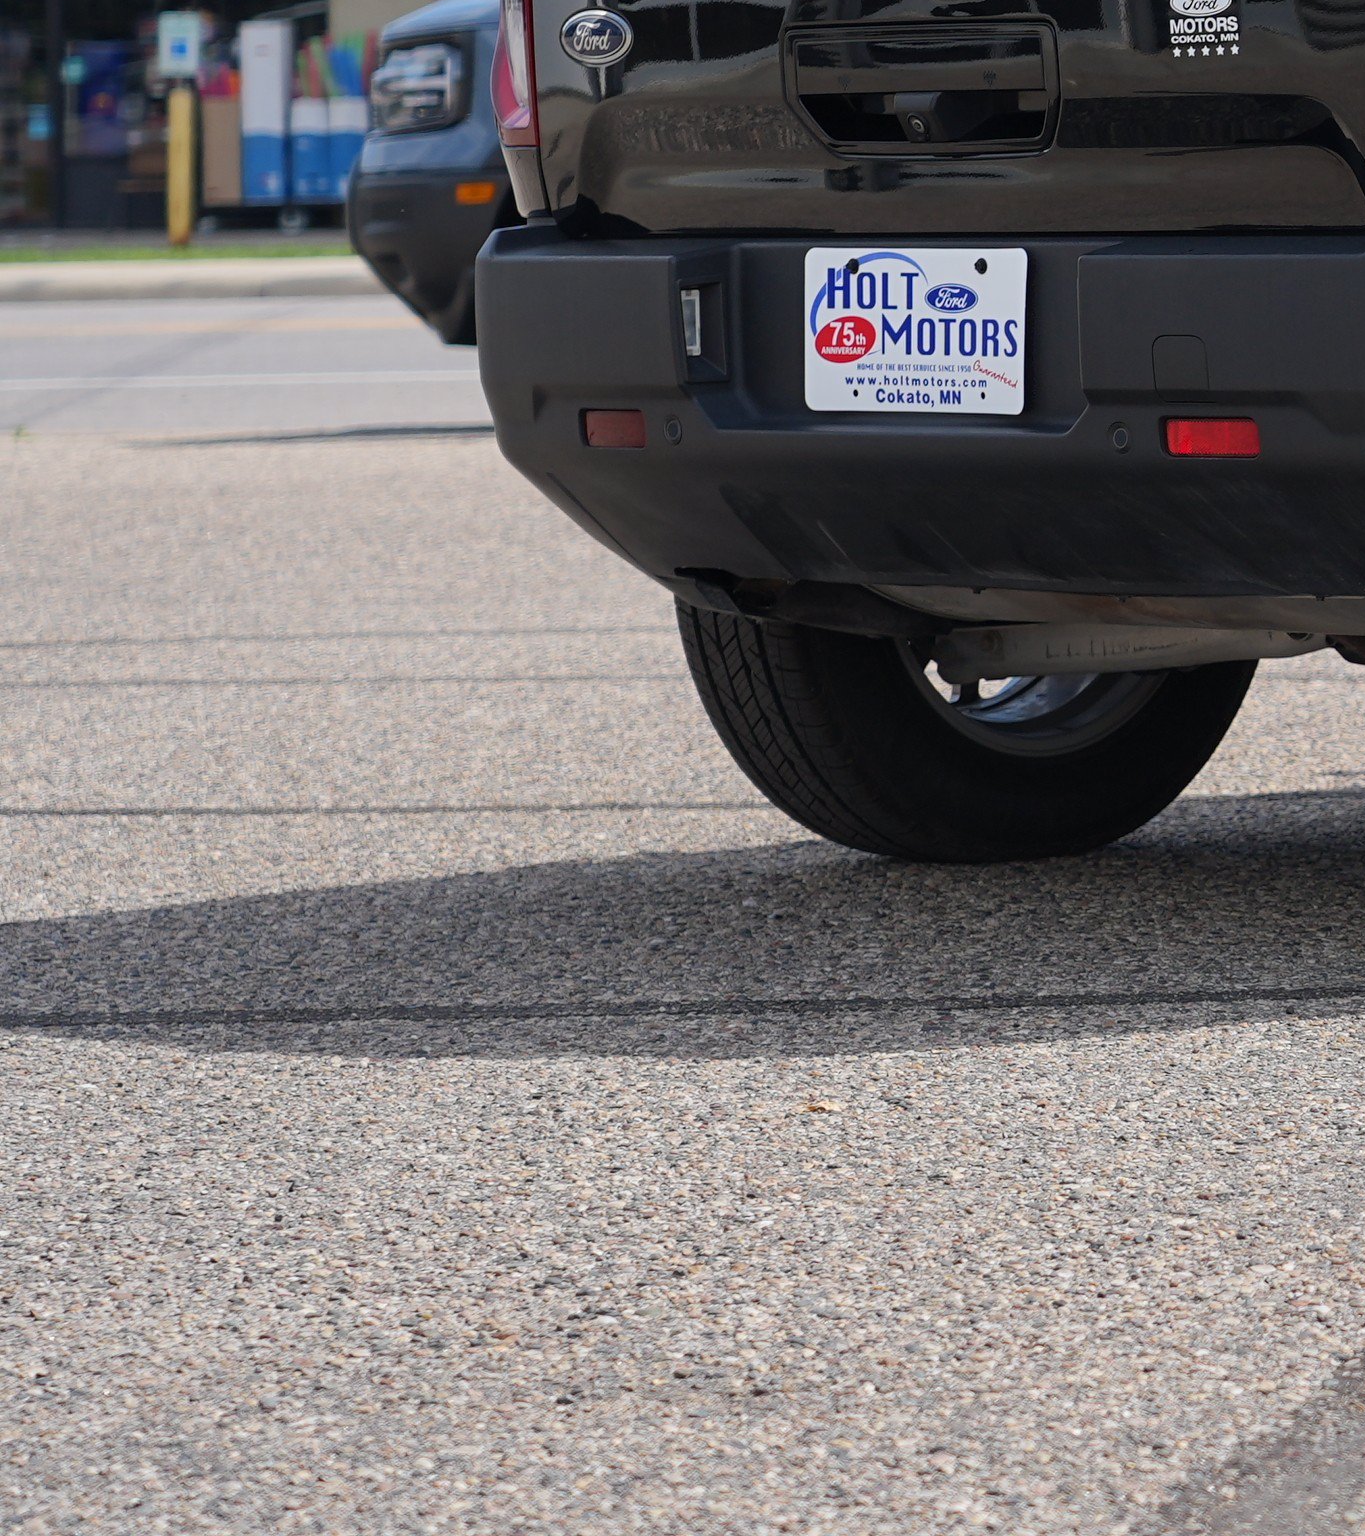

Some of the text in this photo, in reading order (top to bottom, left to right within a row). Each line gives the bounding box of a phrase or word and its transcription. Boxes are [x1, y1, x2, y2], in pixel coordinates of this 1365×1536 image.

[1169, 16, 1239, 35] MOTORS
[573, 21, 613, 52] Ford
[1170, 32, 1239, 44] COKATO, MN
[827, 268, 969, 310] HOLT Ford
[829, 321, 867, 347] 75th
[881, 314, 1018, 358] MOTORS
[821, 346, 866, 355] ANNIVERSARY
[857, 363, 874, 371] HOME
[897, 364, 911, 372] BEST
[957, 365, 972, 373] 1950
[973, 359, 1018, 389] Guaranteed
[845, 375, 987, 388] www.holtmotors.com
[876, 389, 962, 408] Cokato, MN
